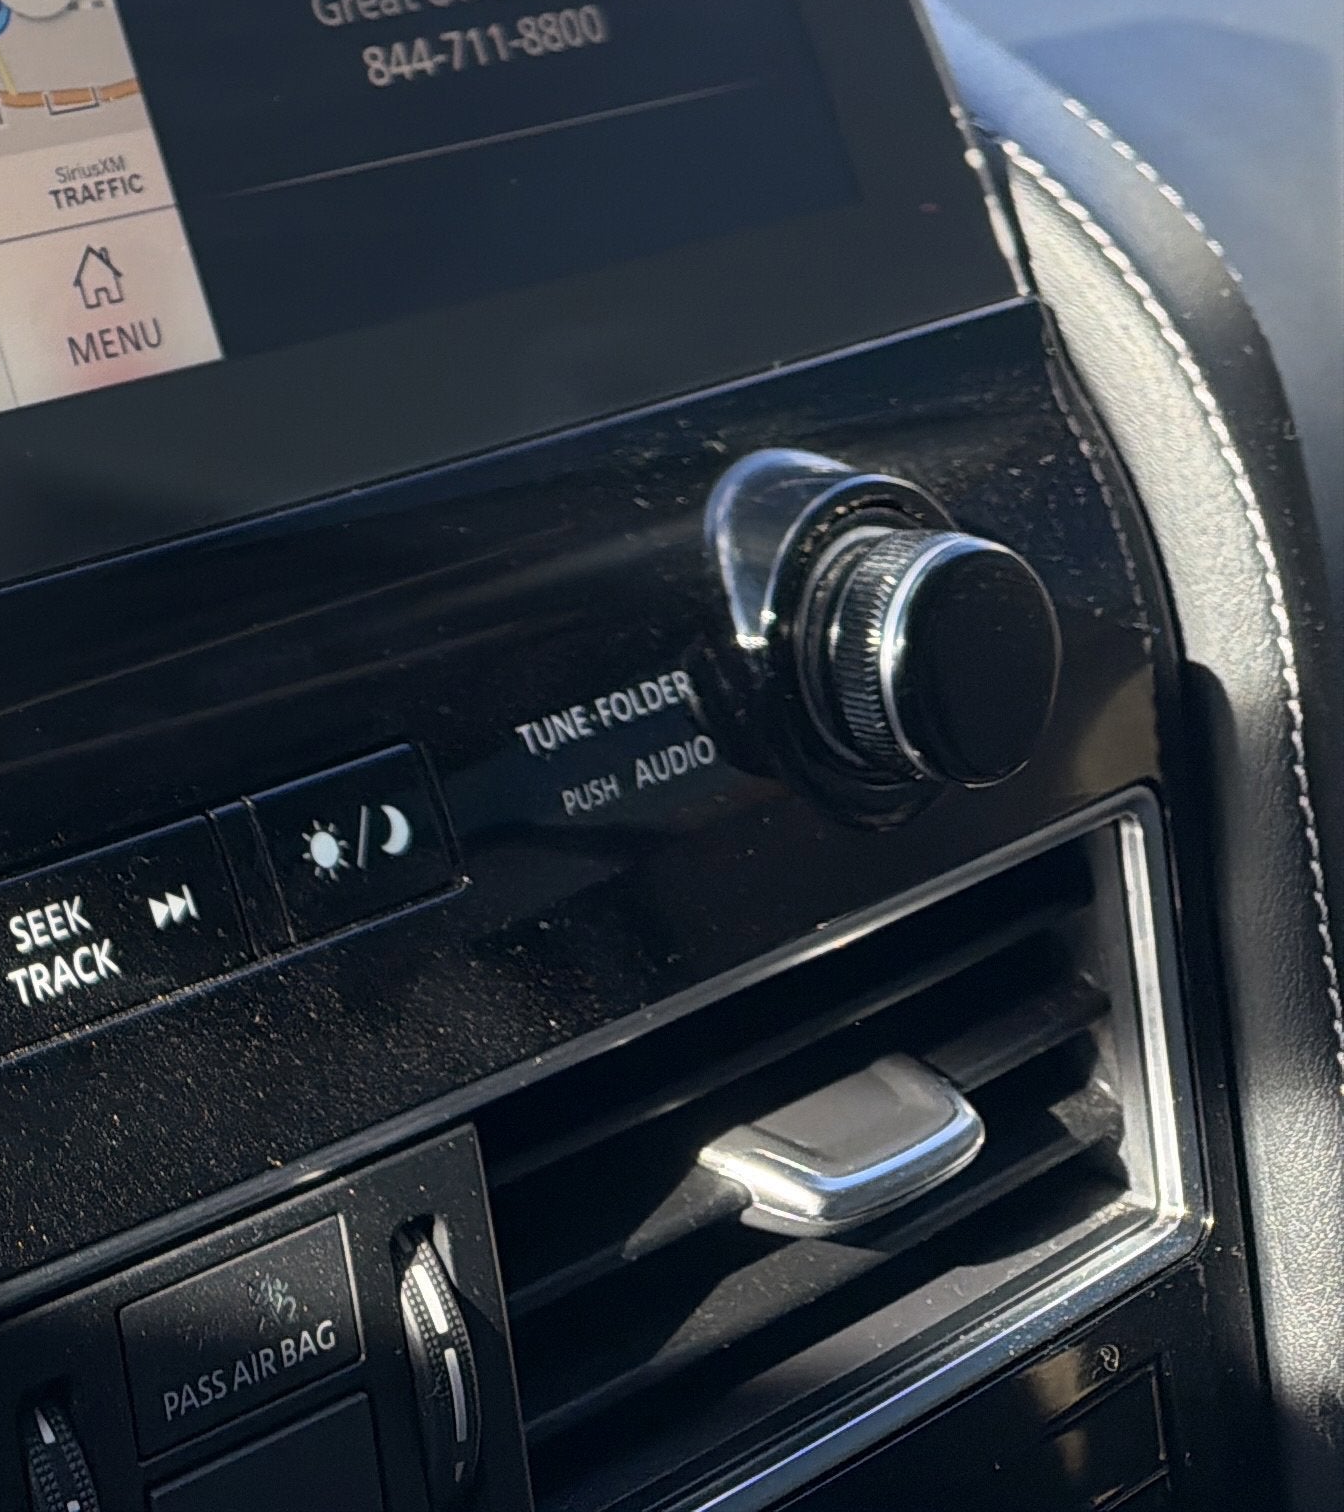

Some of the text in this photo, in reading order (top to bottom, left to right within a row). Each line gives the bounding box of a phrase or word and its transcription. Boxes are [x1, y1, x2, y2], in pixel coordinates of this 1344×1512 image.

[362, 5, 609, 87] 844-711-8800
[48, 173, 145, 211] TRAFFIC
[54, 154, 127, 185] SiriusXM
[67, 317, 163, 368] MENU
[562, 735, 717, 816] PUSH AUDIO
[9, 895, 93, 954] SEEK
[7, 937, 121, 1007] TRACK
[162, 1319, 337, 1422] PASS AIR BAG
